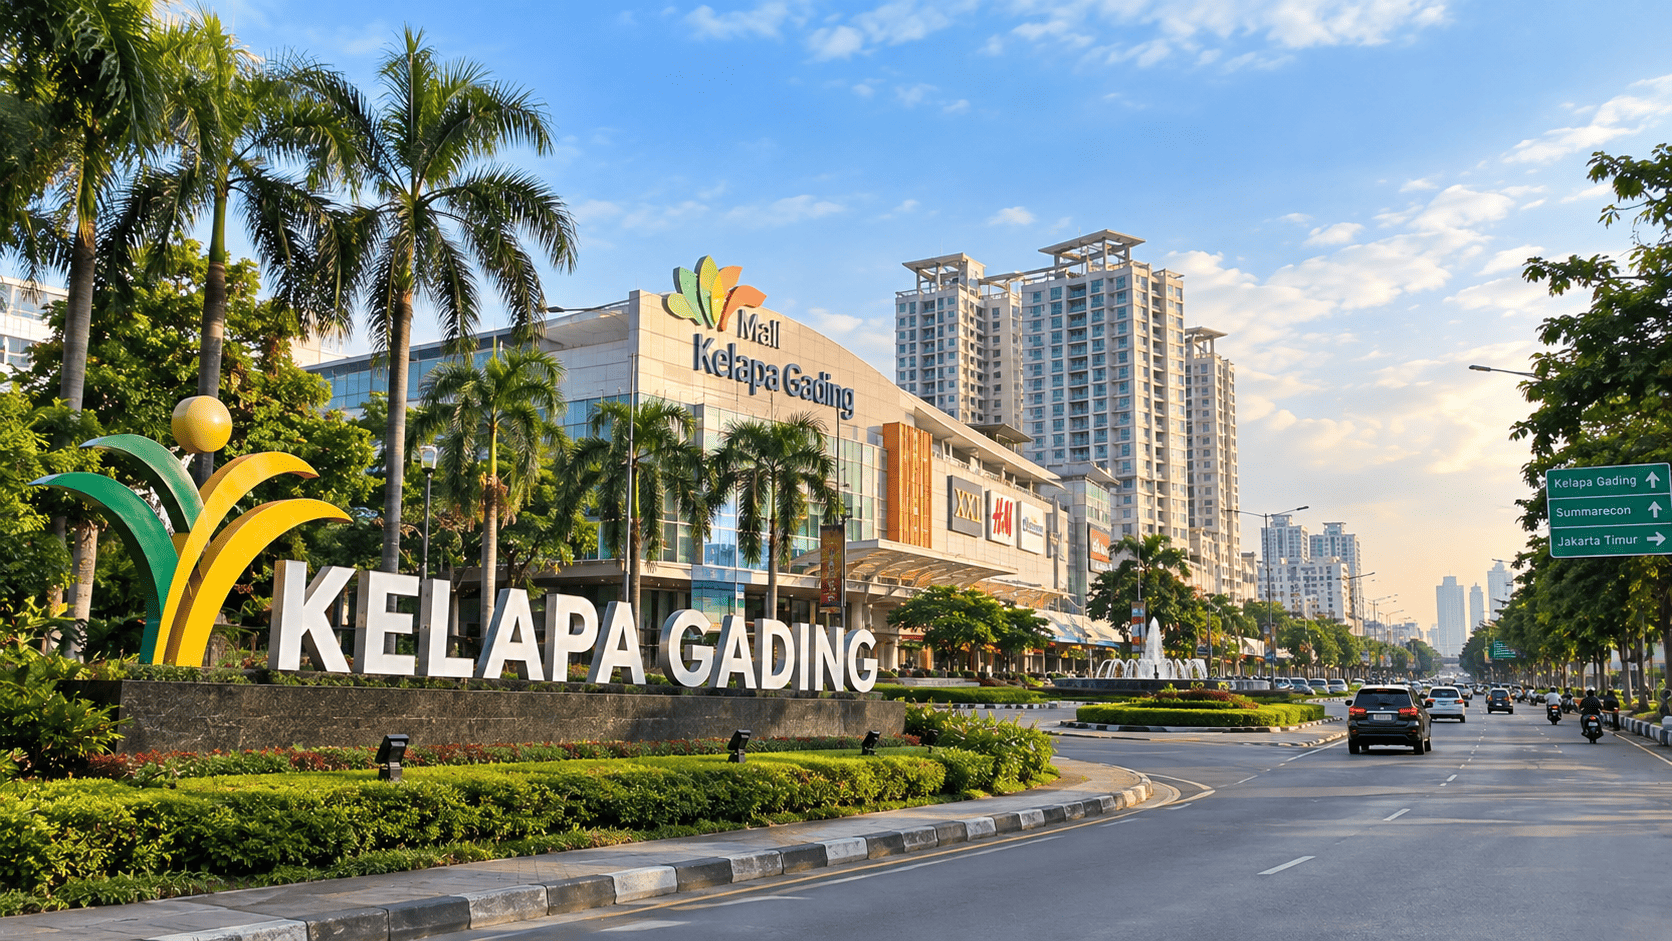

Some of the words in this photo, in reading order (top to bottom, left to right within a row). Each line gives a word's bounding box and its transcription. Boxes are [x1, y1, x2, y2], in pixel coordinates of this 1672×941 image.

[737, 309, 780, 349] Mall
[693, 333, 779, 395] Kelapa
[784, 363, 854, 420] Gading
[1554, 478, 1593, 489] Kelapa
[1597, 475, 1637, 487] Gading
[954, 488, 982, 524] XXI
[1556, 507, 1631, 517] Summarecon
[1558, 536, 1600, 547] Jakarta
[1604, 535, 1638, 545] Timur
[268, 559, 646, 686] KELAPA
[659, 609, 877, 693] GADING
